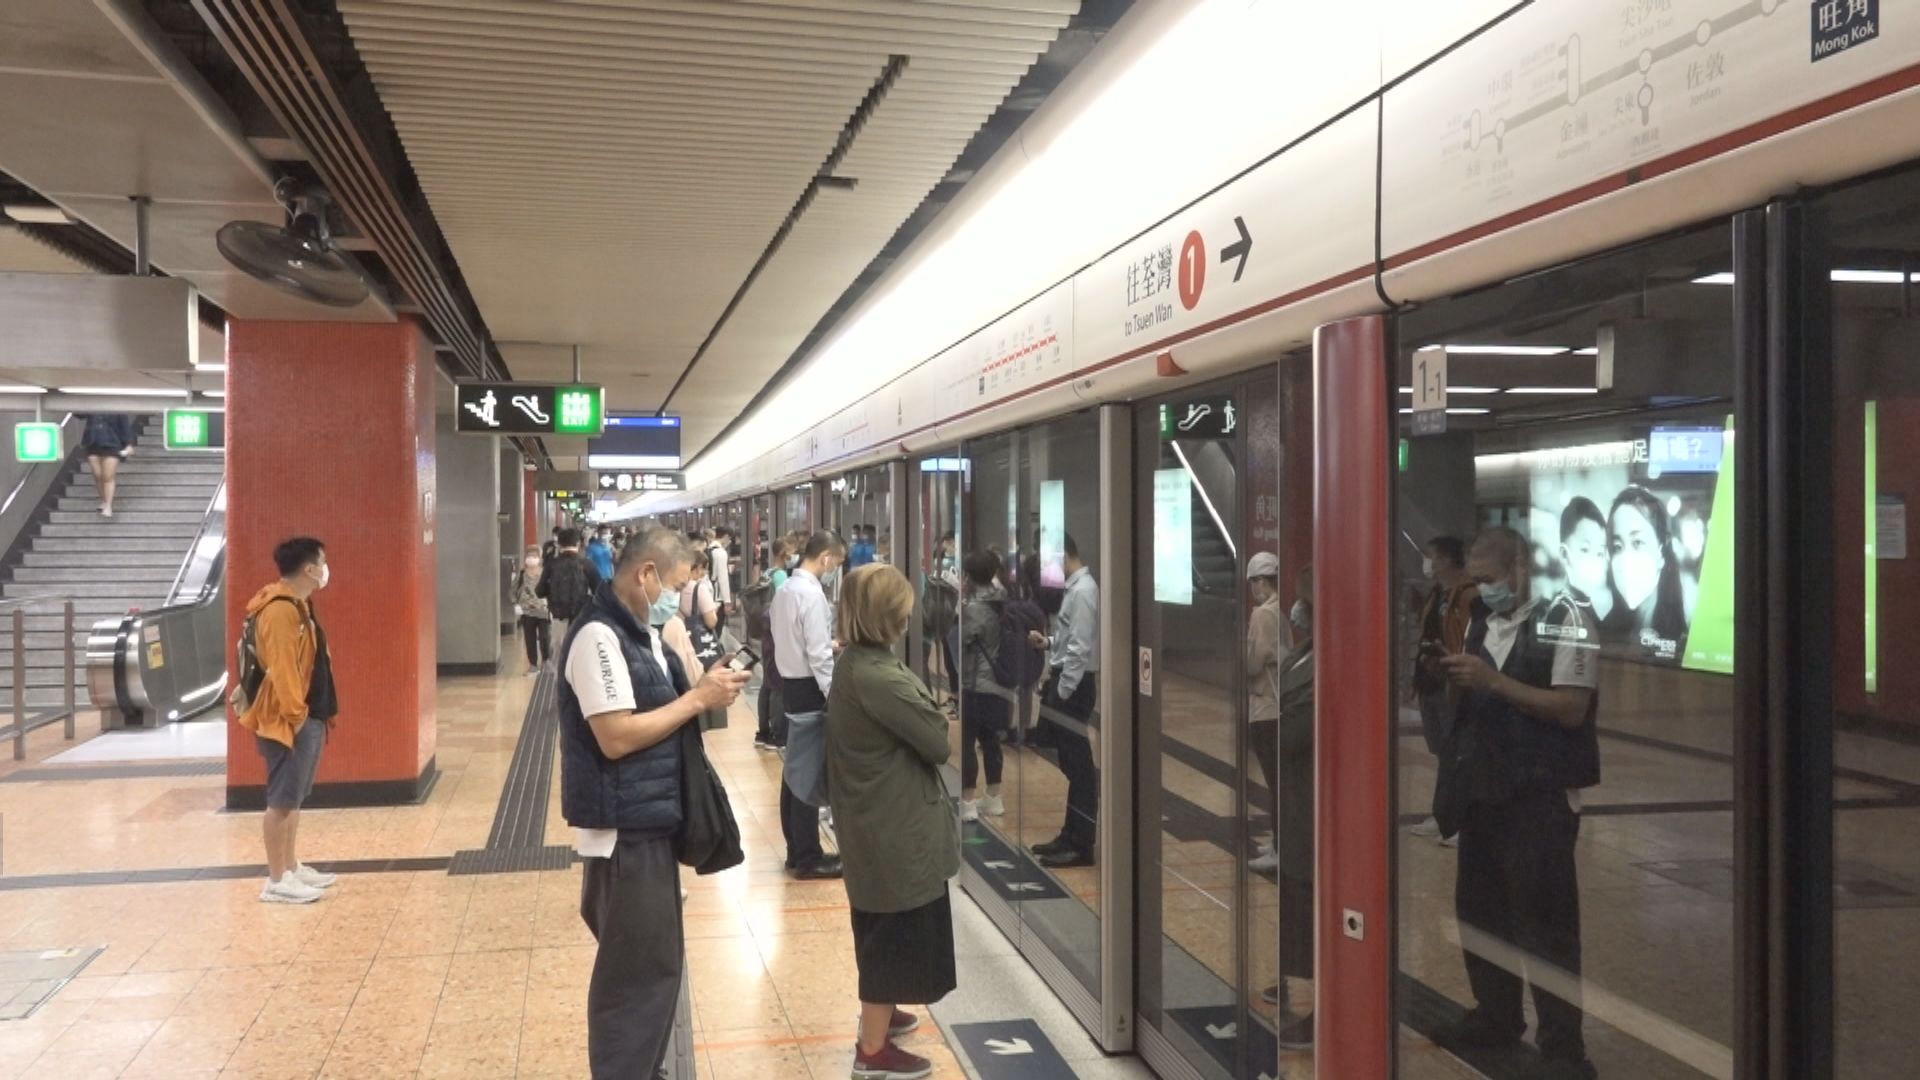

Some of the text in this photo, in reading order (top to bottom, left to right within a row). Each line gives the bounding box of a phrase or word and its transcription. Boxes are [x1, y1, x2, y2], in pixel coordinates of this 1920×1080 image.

[1814, 20, 1875, 57] Mong Kok
[1126, 241, 1173, 307] 往荃灣
[1187, 245, 1196, 296] 1
[1124, 303, 1173, 337] to Tsuen Wan
[1418, 360, 1441, 403] 1-1
[596, 641, 618, 702] COURAGE
